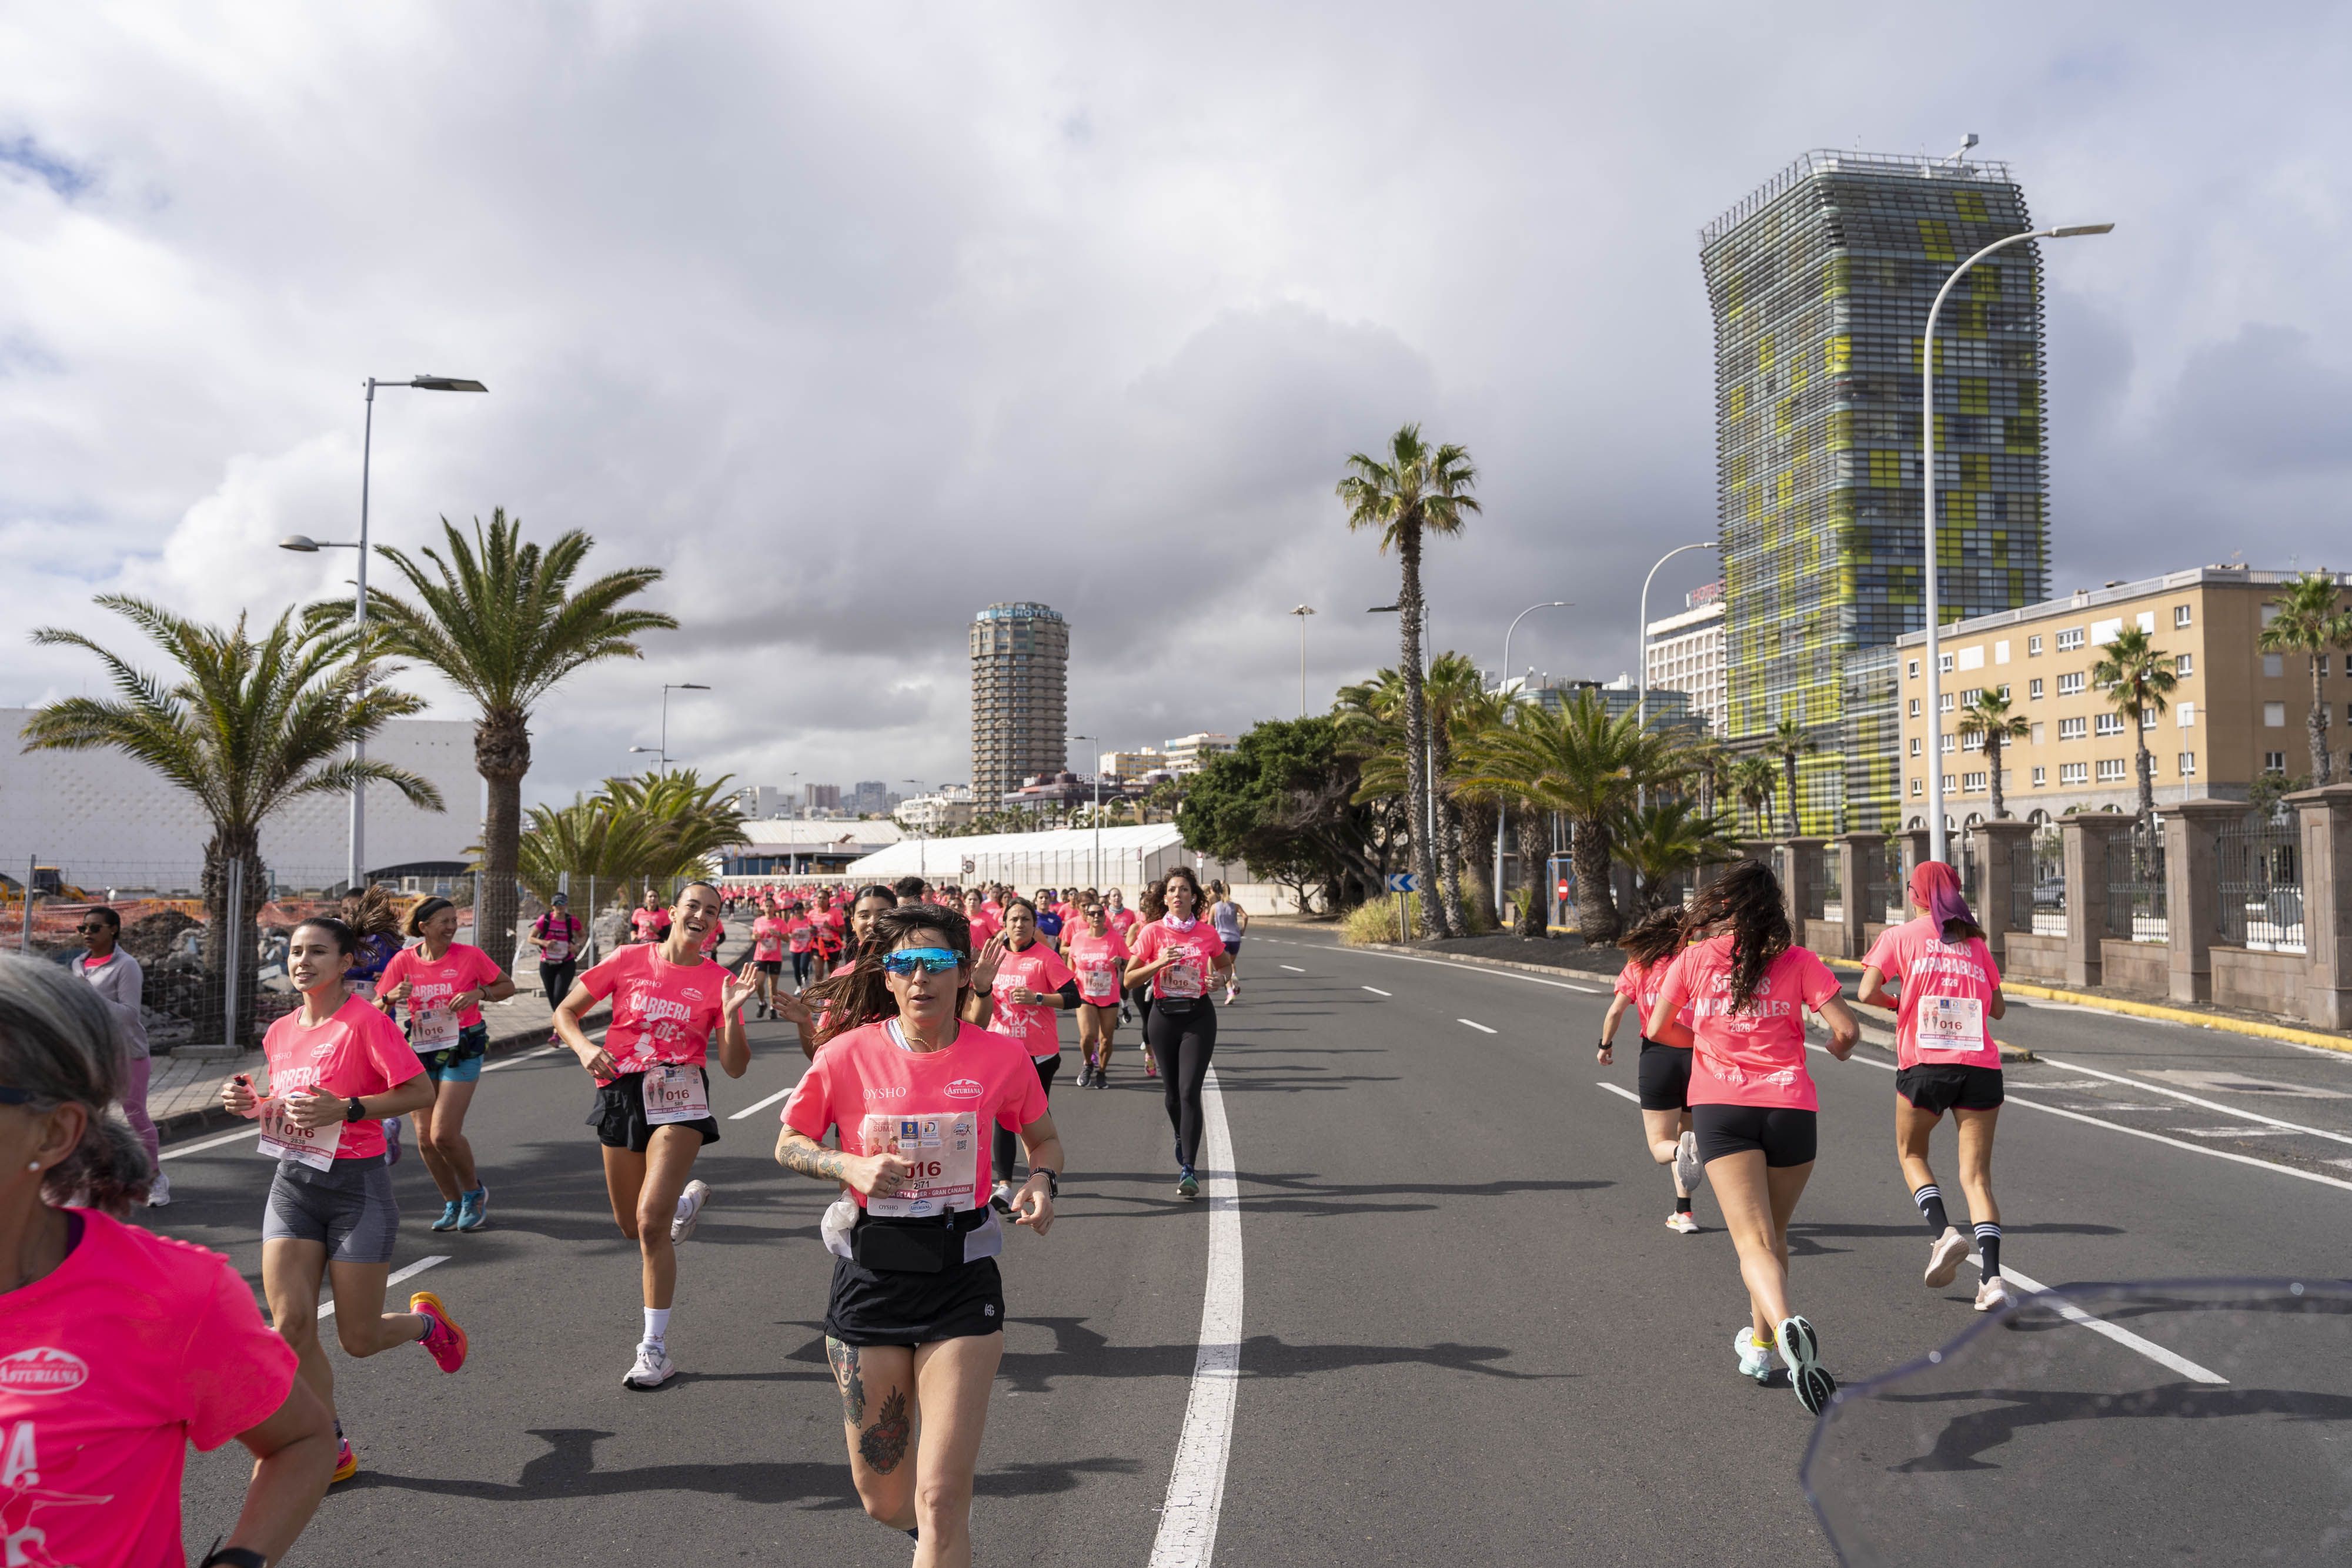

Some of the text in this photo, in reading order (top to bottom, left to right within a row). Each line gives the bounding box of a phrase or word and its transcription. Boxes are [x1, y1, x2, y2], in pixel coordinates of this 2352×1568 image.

[998, 609, 1013, 617] AC
[1926, 938, 1972, 958] SOMOS
[1912, 957, 1986, 982] IMPARABLES
[993, 974, 1027, 987] ARRERA
[1712, 974, 1770, 995] SOS
[630, 991, 691, 1022] CARRERA
[425, 1027, 443, 1035] 016
[1730, 1023, 1750, 1032] 2026
[1940, 1021, 1962, 1030] 016
[666, 1089, 690, 1101] 016
[863, 1086, 906, 1100] OYSHO
